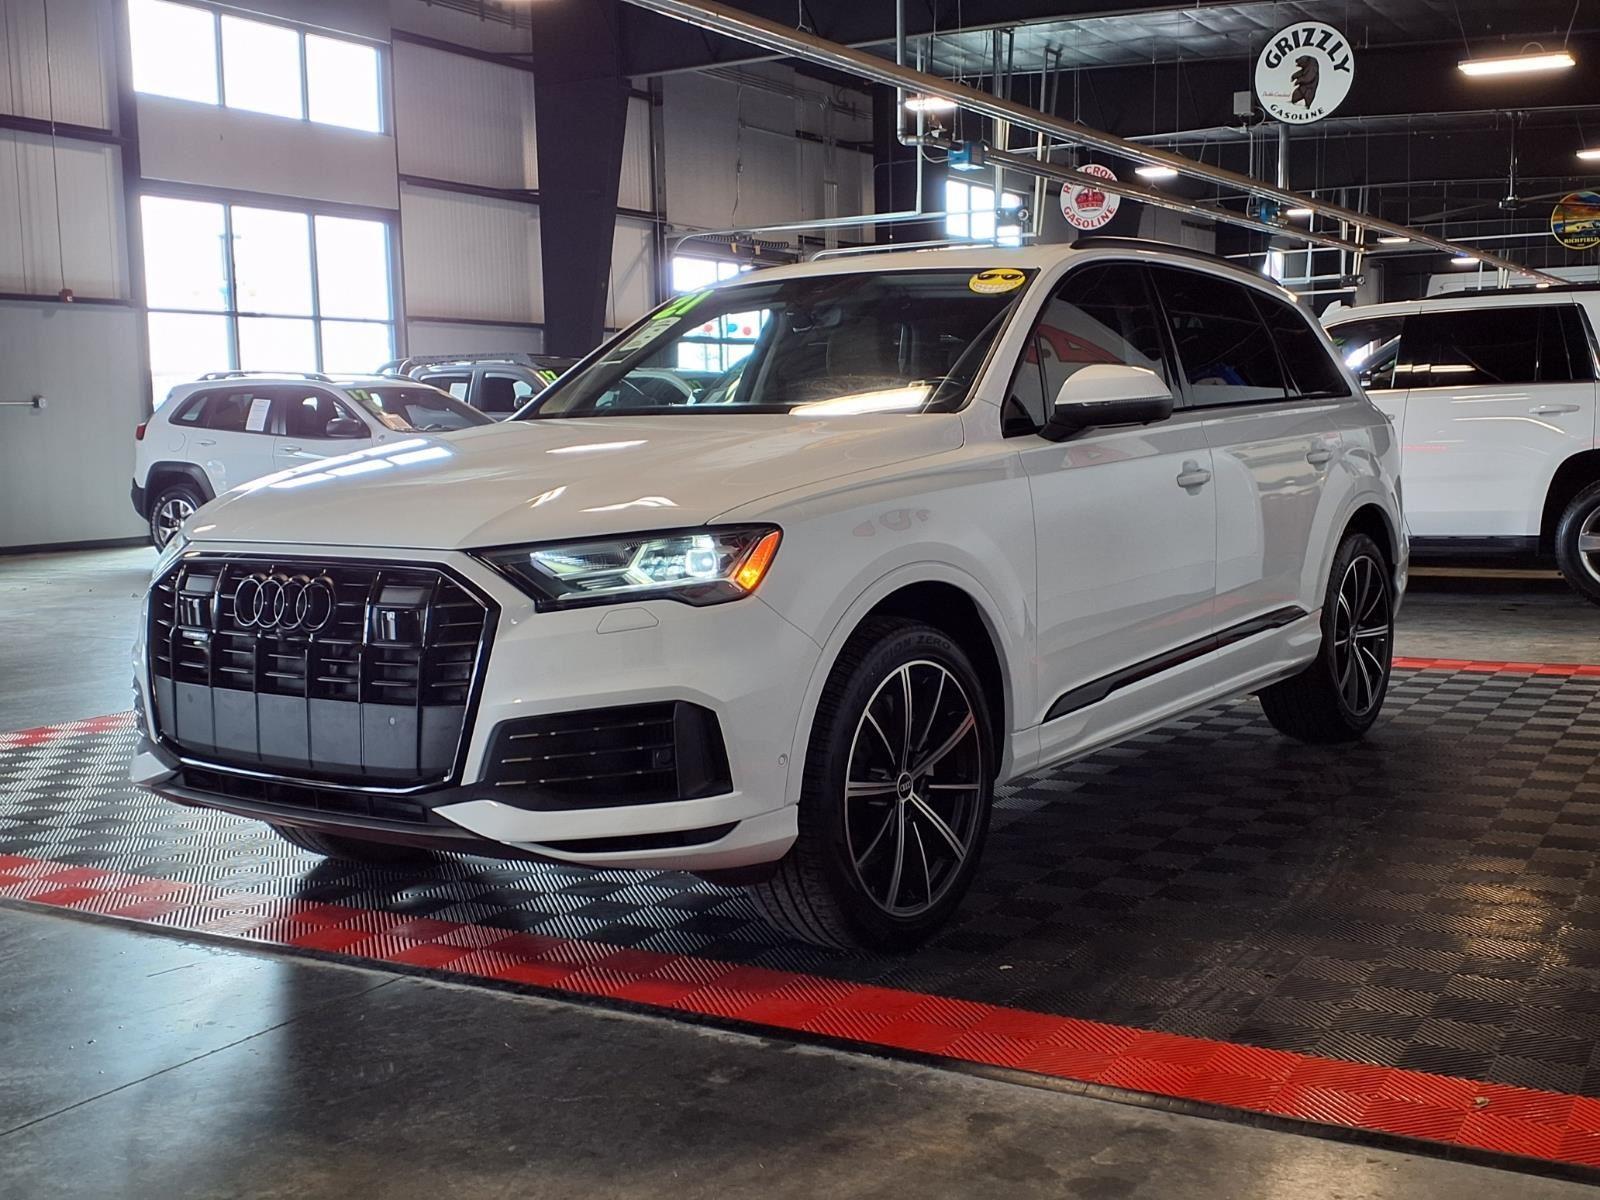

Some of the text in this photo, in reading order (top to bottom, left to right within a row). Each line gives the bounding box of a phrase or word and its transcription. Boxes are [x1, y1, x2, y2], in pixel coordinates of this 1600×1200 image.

[1265, 28, 1350, 73] GRIZZLY
[1270, 104, 1324, 120] GASOLINE
[1084, 166, 1115, 181] CROW
[1063, 206, 1115, 228] GASOLINE
[916, 635, 951, 650] ZERO
